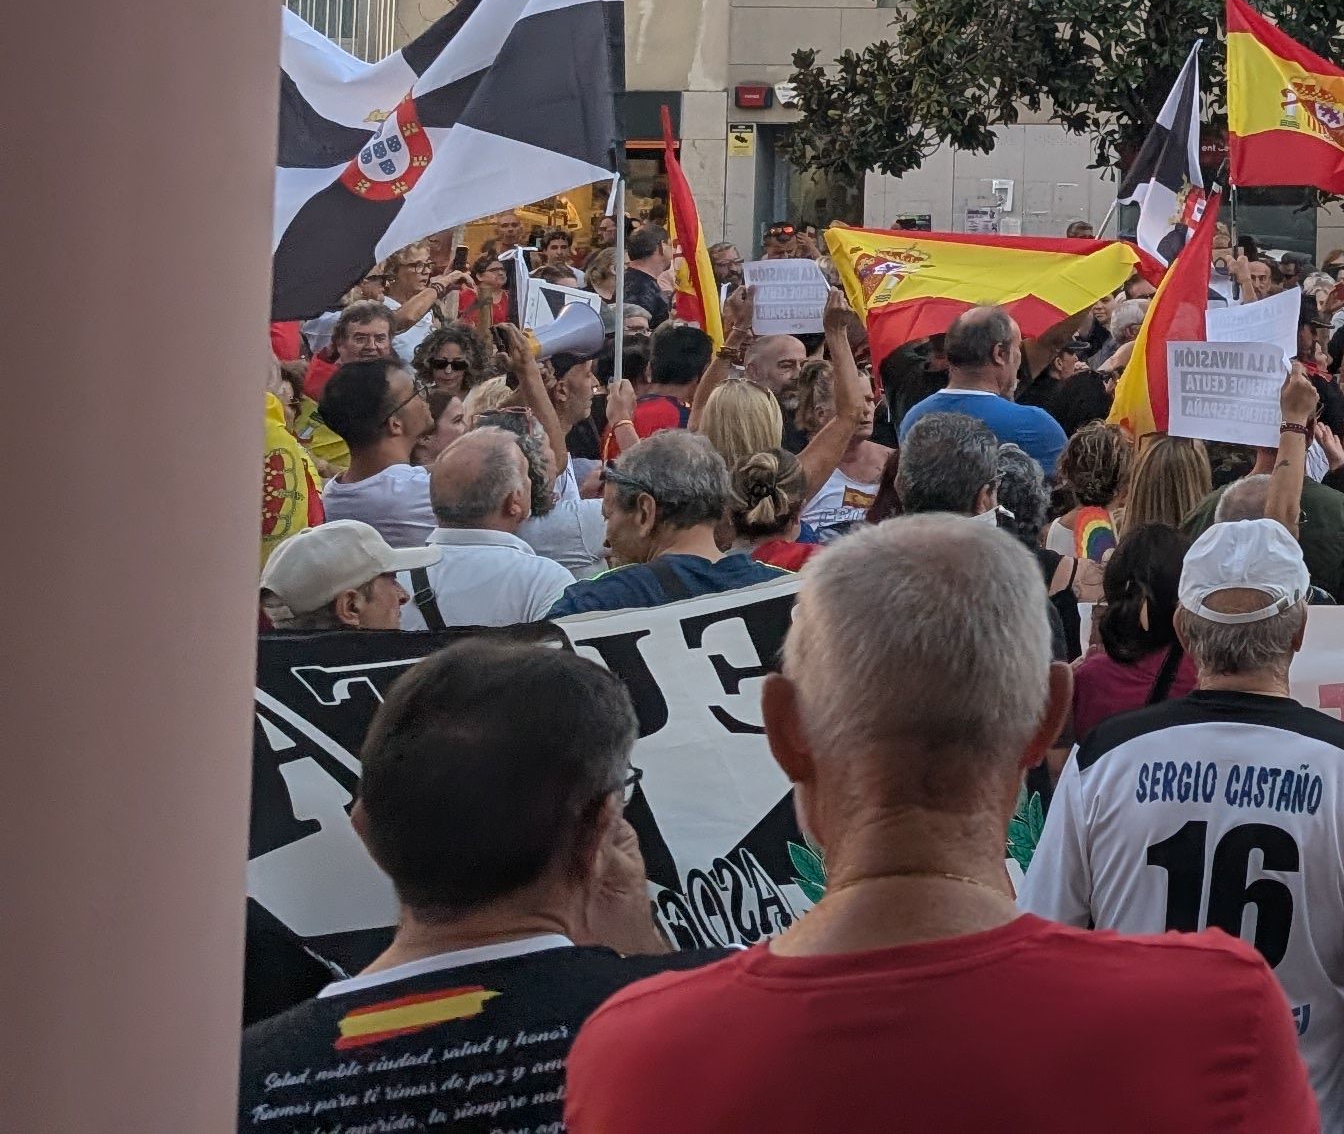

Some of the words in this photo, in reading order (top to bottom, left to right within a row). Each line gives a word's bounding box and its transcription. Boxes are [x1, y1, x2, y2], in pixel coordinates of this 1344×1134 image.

[1136, 760, 1217, 804] SERGIO
[1224, 763, 1323, 815] CASTAÑO
[1147, 820, 1299, 969] 16
[514, 1024, 569, 1048] honor
[314, 1094, 359, 1117] para
[385, 1082, 437, 1099] rimas
